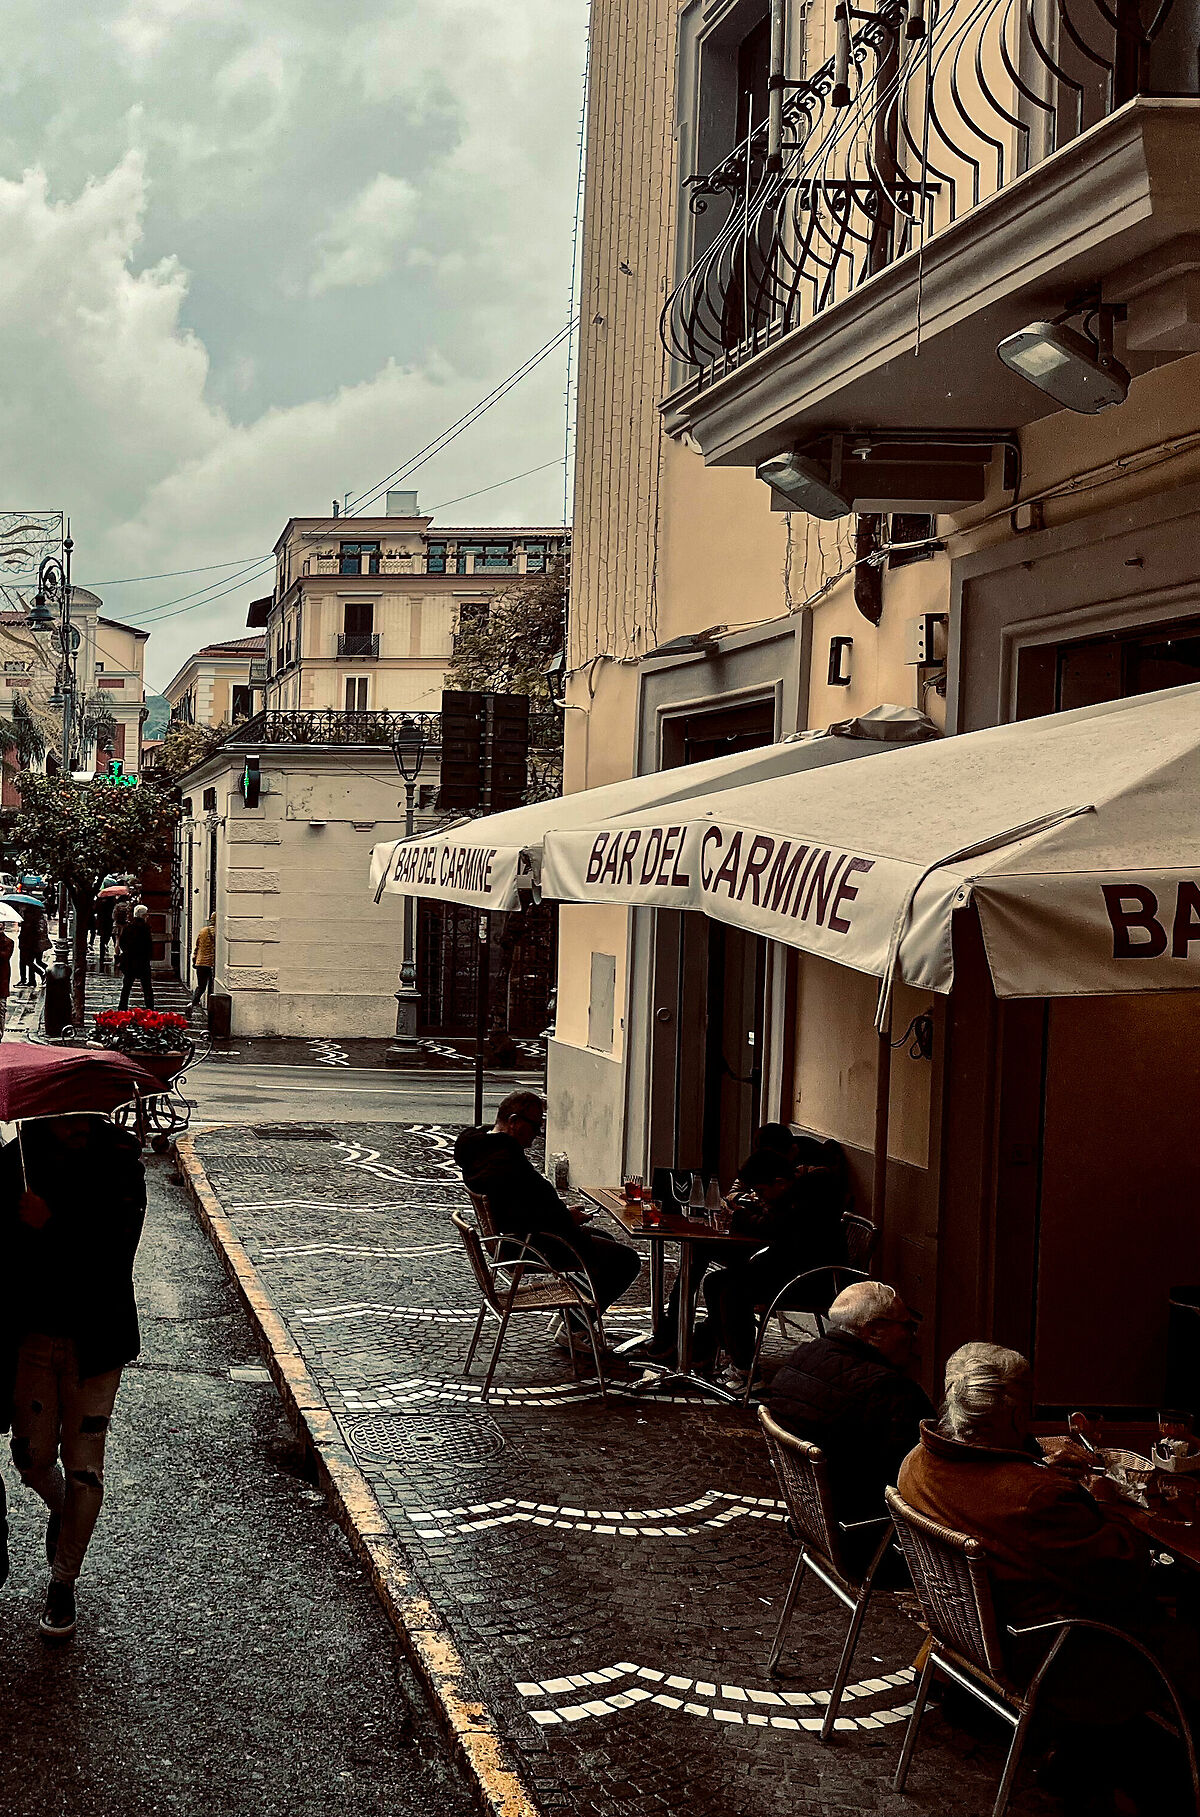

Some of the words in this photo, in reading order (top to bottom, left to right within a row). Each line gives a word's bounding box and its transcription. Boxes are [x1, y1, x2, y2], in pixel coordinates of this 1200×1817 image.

[393, 847, 419, 882] BAR
[417, 846, 438, 884] DEL
[440, 846, 497, 893] CARMINE
[586, 831, 640, 885] BAR
[639, 826, 689, 887] DEL
[701, 825, 876, 934] CARMINE
